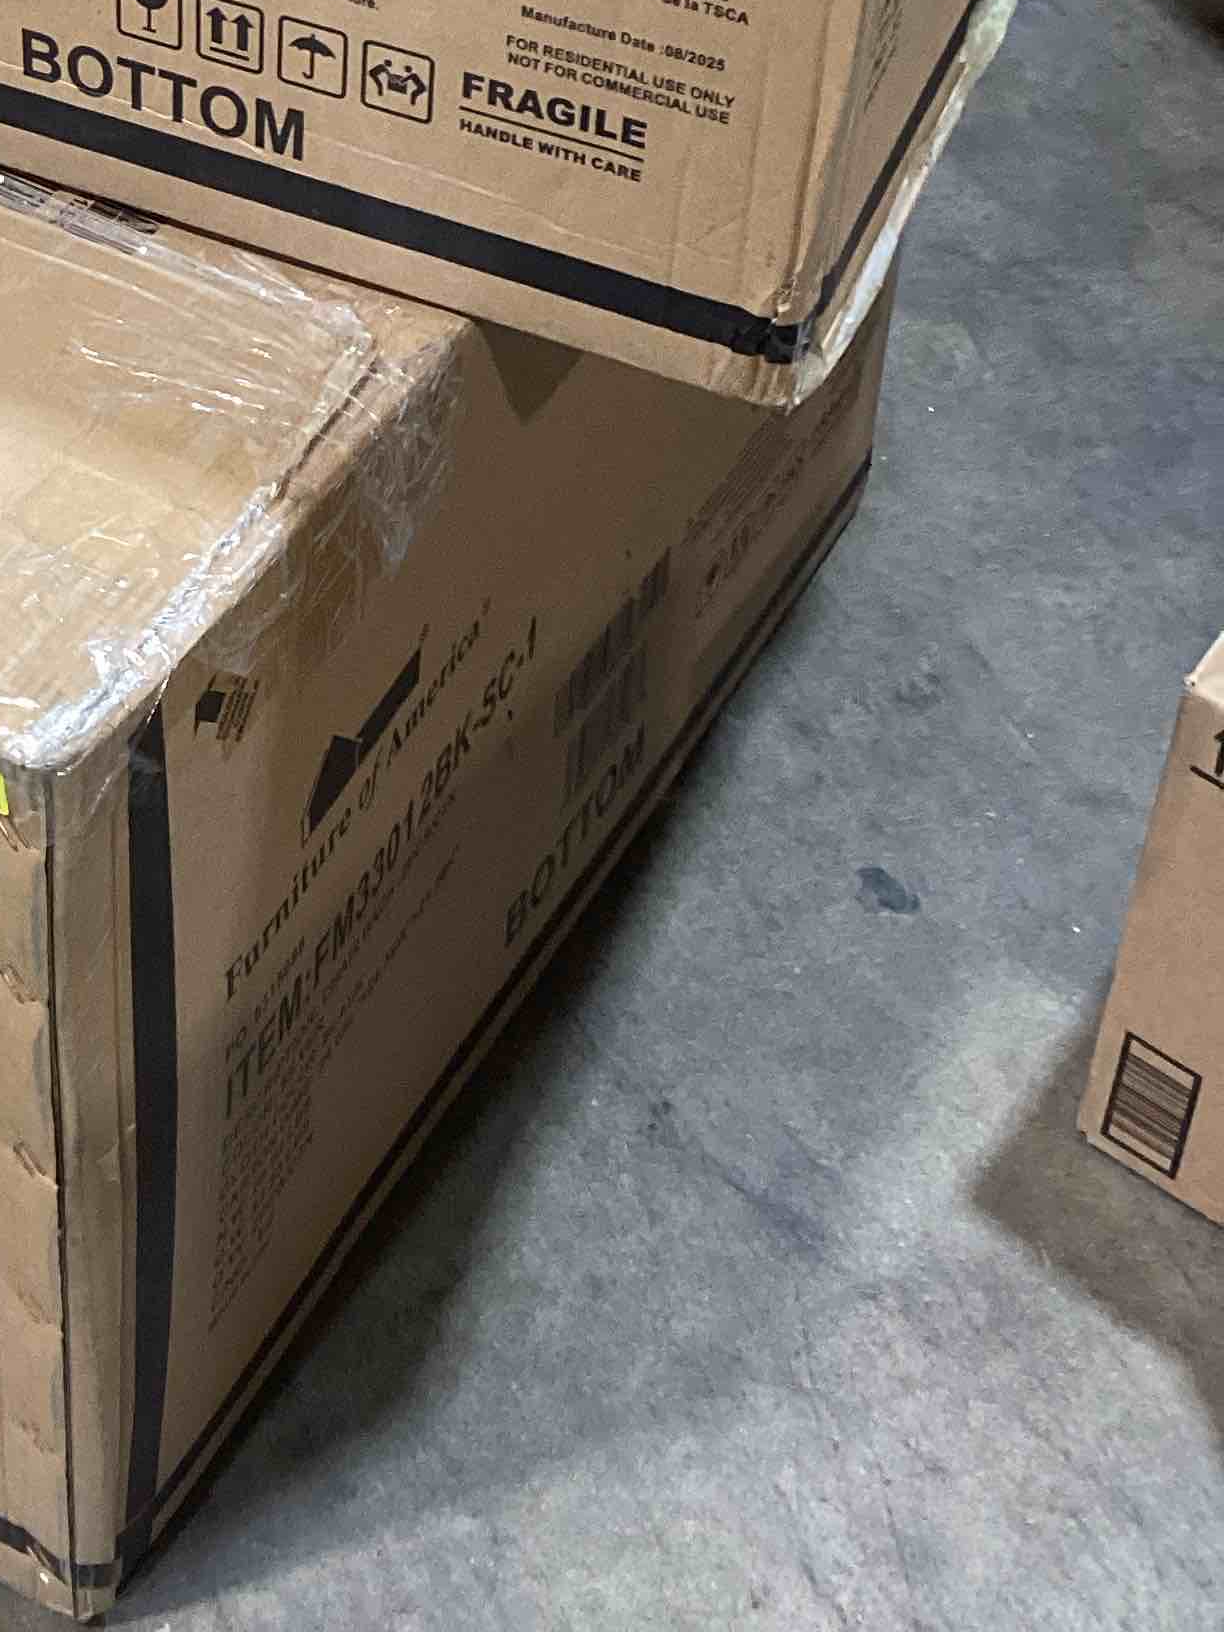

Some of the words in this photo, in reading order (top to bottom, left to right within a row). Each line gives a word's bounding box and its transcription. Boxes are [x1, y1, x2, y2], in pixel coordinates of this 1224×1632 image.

[520, 4, 617, 41] Manufacture
[619, 30, 655, 53] Date
[702, 0, 749, 26] TSCA
[20, 26, 305, 162] BOTTOM
[505, 33, 539, 54] FOR
[542, 43, 649, 85] RESIDENTIAL
[651, 74, 686, 96] USE
[689, 85, 735, 108] ONLY
[506, 51, 541, 70] NOT
[542, 60, 577, 82] FOR
[580, 71, 691, 114] COMMERCIAL
[694, 103, 730, 125] USE
[461, 70, 648, 150] FRAGILE
[458, 117, 533, 151] HANDLE
[537, 140, 586, 166] WITH
[590, 156, 641, 183] CARE
[504, 720, 646, 948] BOTTOM
